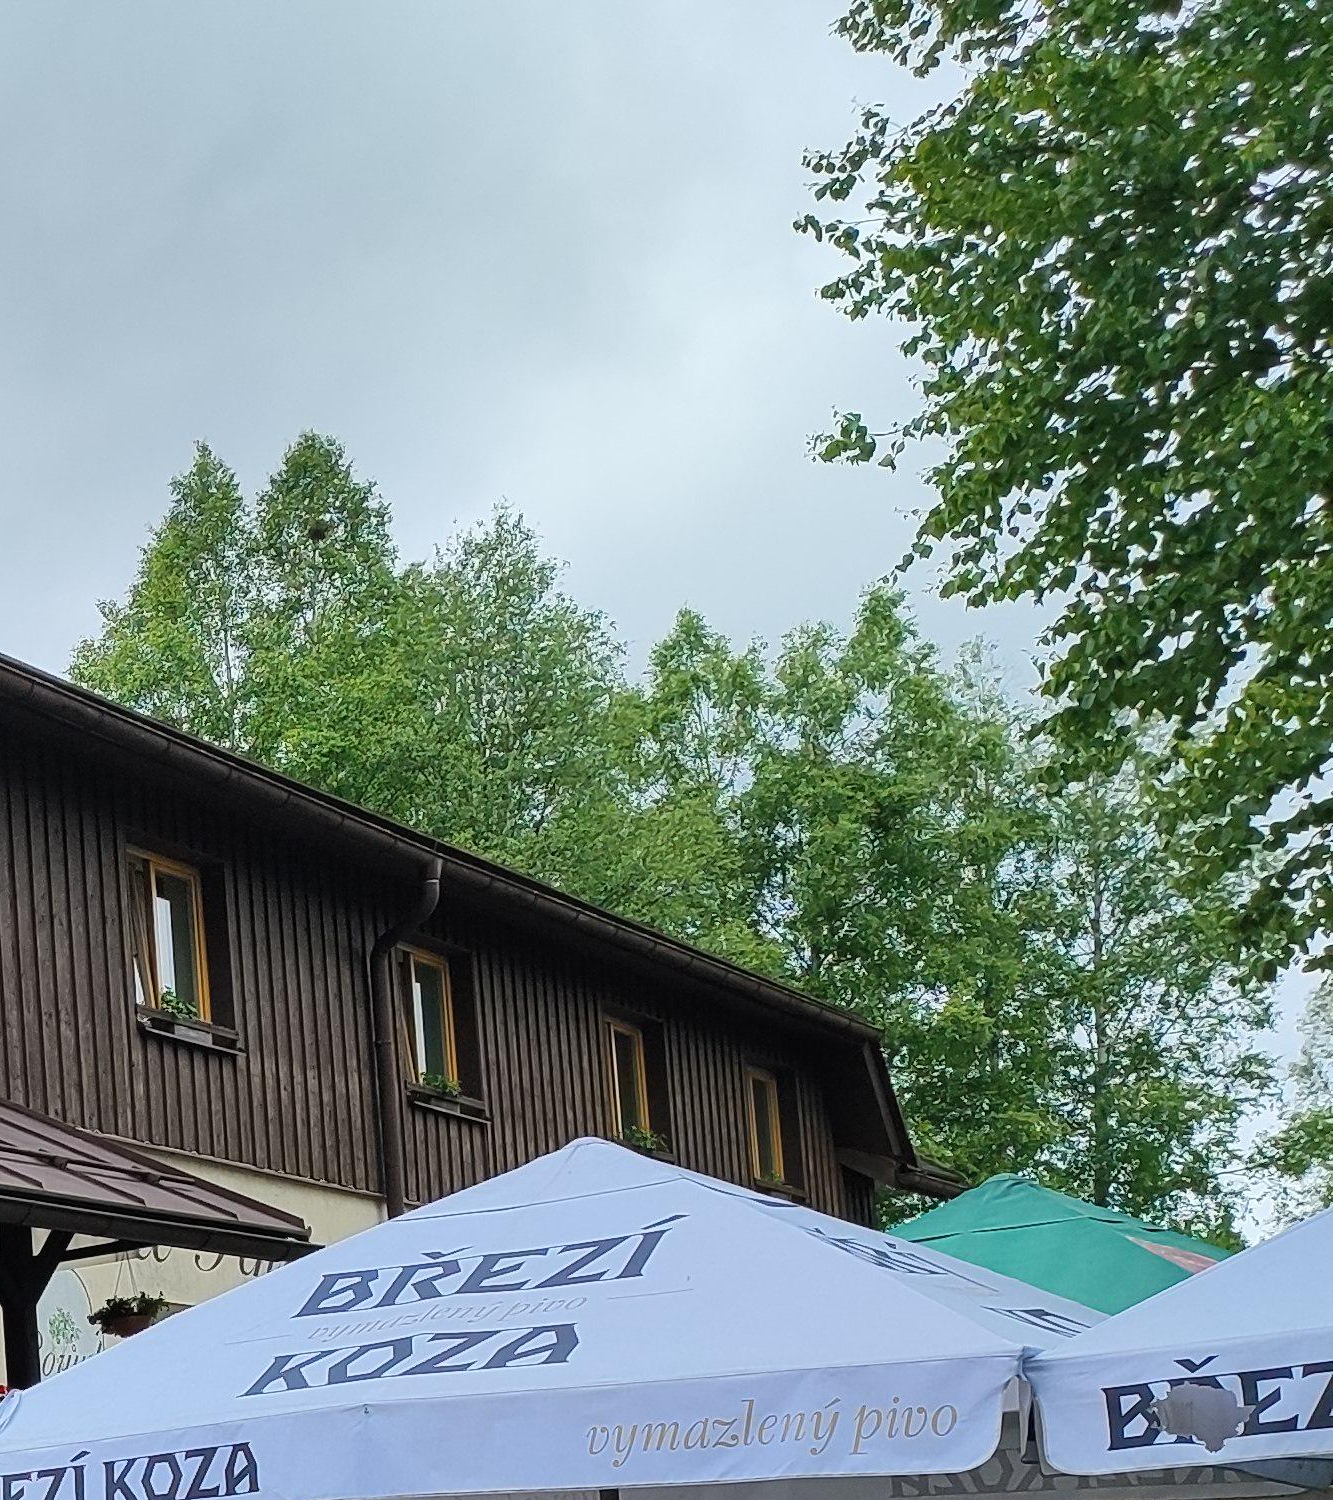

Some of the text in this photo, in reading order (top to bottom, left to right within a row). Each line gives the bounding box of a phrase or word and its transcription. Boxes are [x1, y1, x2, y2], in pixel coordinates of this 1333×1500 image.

[290, 1214, 690, 1318] BŘEZÍ
[498, 1296, 588, 1322] pivo
[236, 1323, 579, 1397] KOZA
[585, 1396, 957, 1468] vymazlený pivo
